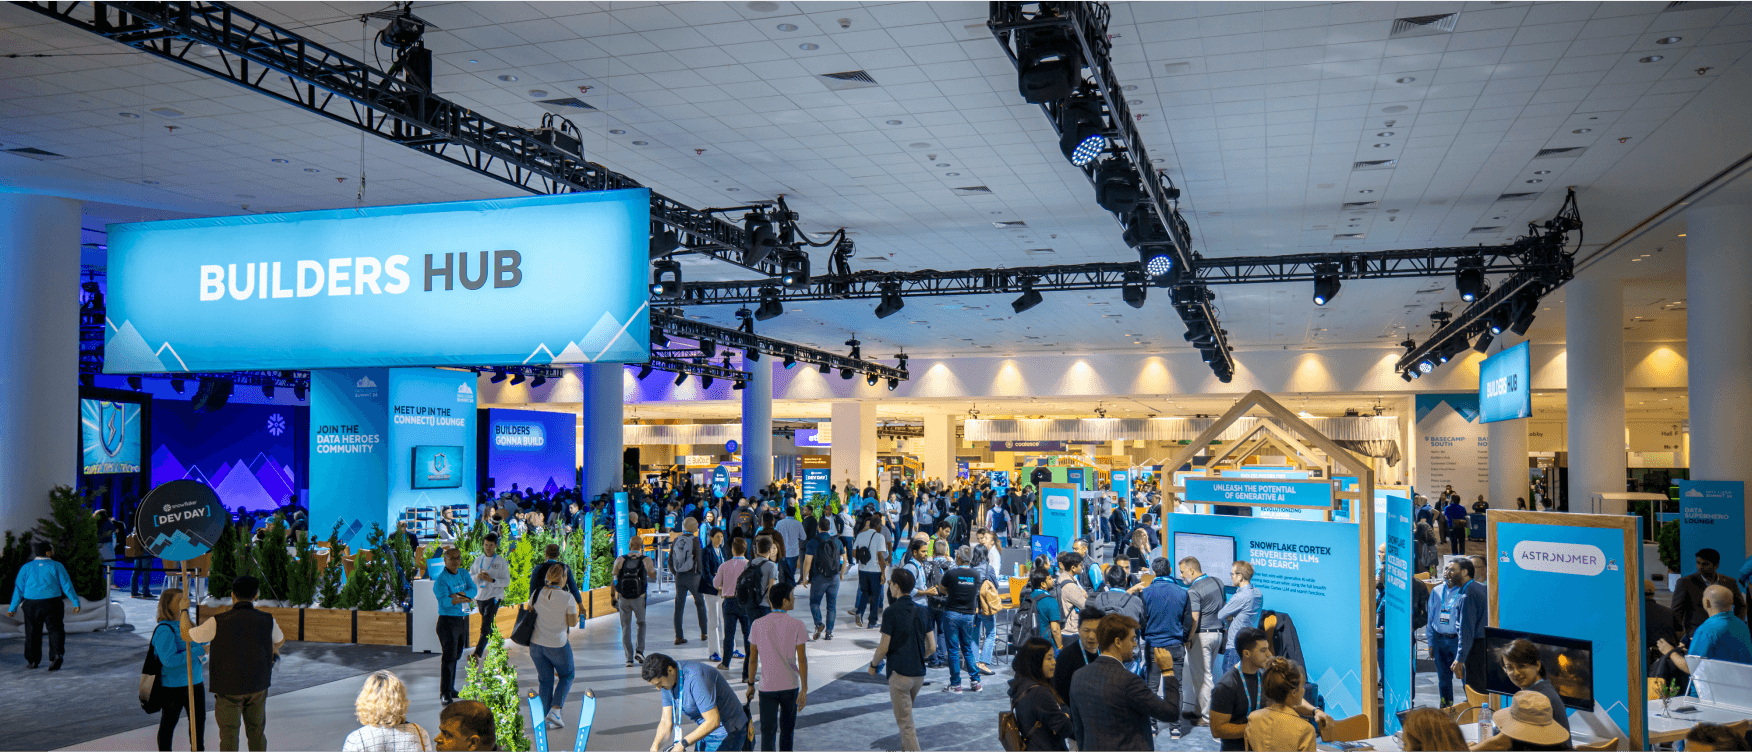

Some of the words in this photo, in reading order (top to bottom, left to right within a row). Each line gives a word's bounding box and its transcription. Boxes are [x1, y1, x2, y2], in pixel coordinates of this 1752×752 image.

[200, 254, 411, 301] BUILDERS
[423, 249, 523, 292] HUB
[1486, 376, 1507, 398] BUILDERS
[1507, 374, 1518, 392] HUB
[394, 406, 415, 415] MEET
[416, 406, 427, 415] UP
[428, 407, 437, 416] IN
[437, 408, 451, 416] THE
[394, 415, 435, 426] CONNECT()
[436, 417, 465, 427] LOUNGE
[317, 425, 339, 434] JOIN
[341, 425, 359, 434] THE
[495, 425, 530, 435] BUILDERS
[317, 435, 341, 444] DATA
[343, 434, 380, 444] HEROES
[495, 435, 521, 446] GONNA
[523, 436, 544, 446] BUILD
[317, 444, 374, 454] COMMUNITY
[1213, 484, 1243, 492] UNLEASH
[1258, 485, 1296, 494] POTENTIAL
[1235, 492, 1276, 501] GENERATIVE
[153, 511, 182, 528] [DEV
[183, 504, 211, 520] DAY]
[1684, 512, 1729, 520] SUPERHERO
[1250, 540, 1297, 552] SNOWFLAKE
[1298, 545, 1331, 555] CORTEX
[1250, 549, 1297, 561] SERVERLESS
[1299, 553, 1319, 563] LLMs
[1521, 551, 1597, 565] ASTRONOMER
[1250, 558, 1267, 567] AND
[1268, 559, 1299, 570] SEARCH
